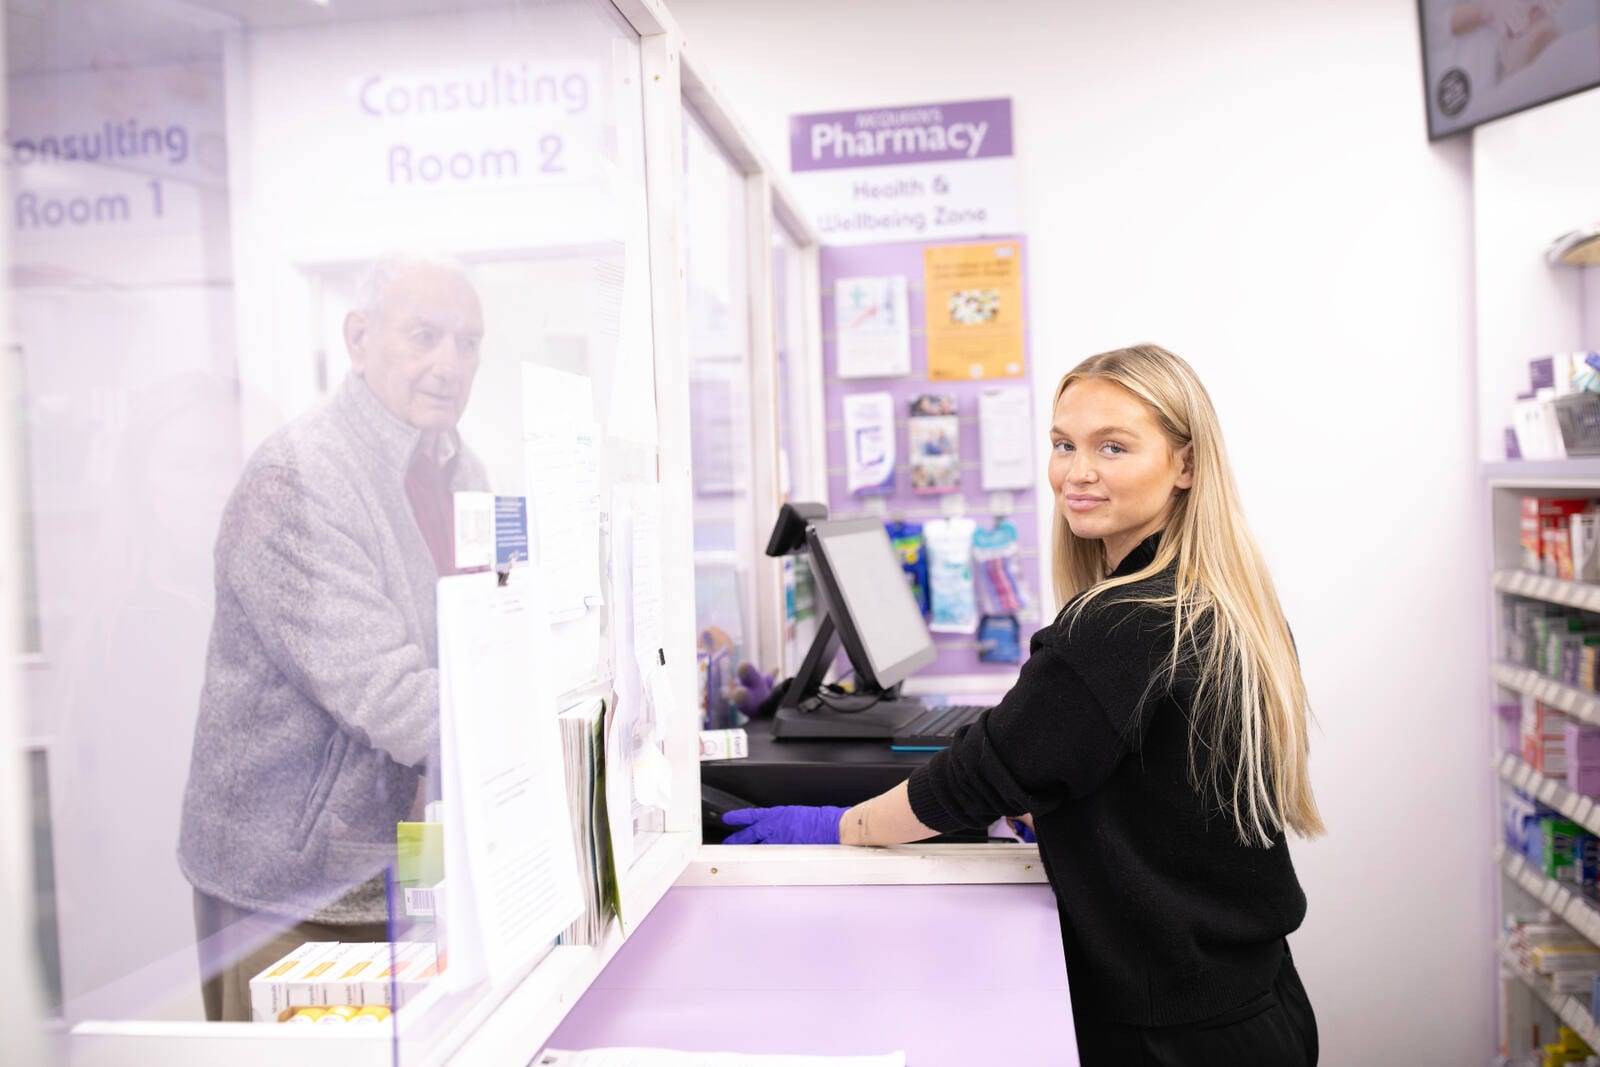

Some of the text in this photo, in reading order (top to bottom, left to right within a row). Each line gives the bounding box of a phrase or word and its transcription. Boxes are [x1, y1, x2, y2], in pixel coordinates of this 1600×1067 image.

[359, 65, 589, 115] Consulting
[388, 134, 567, 184] Room 2
[810, 121, 987, 159] Pharmacy
[16, 180, 164, 228] Room 1
[854, 173, 949, 199] Health &
[818, 206, 987, 232] Wellbeing Zone
